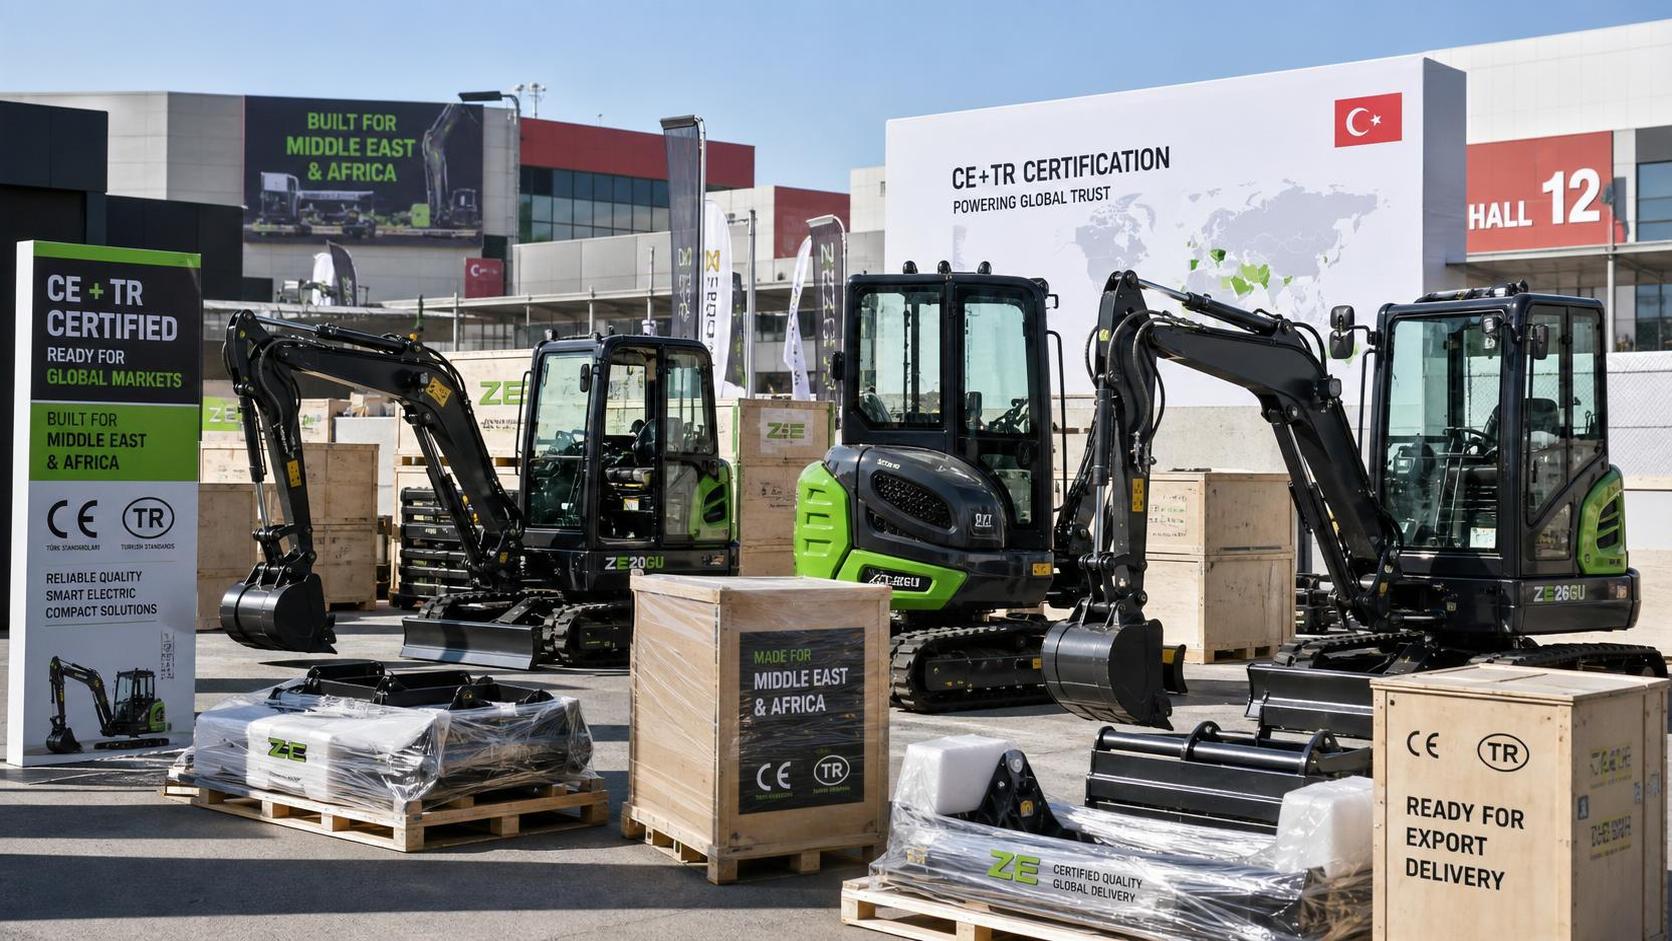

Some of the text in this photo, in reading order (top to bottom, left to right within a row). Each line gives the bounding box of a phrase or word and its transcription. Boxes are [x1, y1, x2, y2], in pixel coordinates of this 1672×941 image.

[307, 112, 397, 131] BUILT FOR
[286, 136, 416, 157] MIDDLE EAST
[308, 162, 397, 182] & AFRICA
[952, 146, 1170, 189] CE+TR CERTIFICATION
[953, 186, 1111, 214] POWERING GLOBAL TRUST
[1468, 167, 1600, 230] HALL 12
[47, 274, 81, 302] CE
[110, 278, 144, 306] TR
[47, 310, 178, 341] CERTIFIED
[48, 347, 125, 365] READY FOR
[47, 368, 182, 388] GLOBAL MARKETS
[48, 411, 118, 427] BUILT FOR
[48, 432, 147, 448] MIDDLE EAST
[47, 454, 120, 470] & AFRICA
[47, 500, 98, 539] CE
[132, 508, 164, 528] TR
[605, 555, 664, 570] ZE20GU
[46, 571, 143, 585] RELIABLE QUALITY
[46, 587, 136, 601] SMART ELECTRIC
[1534, 584, 1585, 602] ZE26GU
[45, 603, 157, 619] COMPACT SOLUTIONS
[754, 649, 811, 664] MADE FOR
[754, 667, 848, 690] MIDDLE EAST
[754, 694, 826, 716] & AFRICA
[1407, 730, 1439, 759] CE
[1487, 742, 1518, 764] TR
[756, 761, 791, 791] CE
[821, 762, 843, 779] TR
[1407, 796, 1524, 830] READY FOR
[1406, 827, 1487, 856] EXPORT
[987, 849, 1040, 885] ZE
[1054, 864, 1143, 889] CERTIFIED QUALITY
[1406, 857, 1505, 891] DELIVERY
[1053, 879, 1136, 903] GLOBAL DELIVERY
